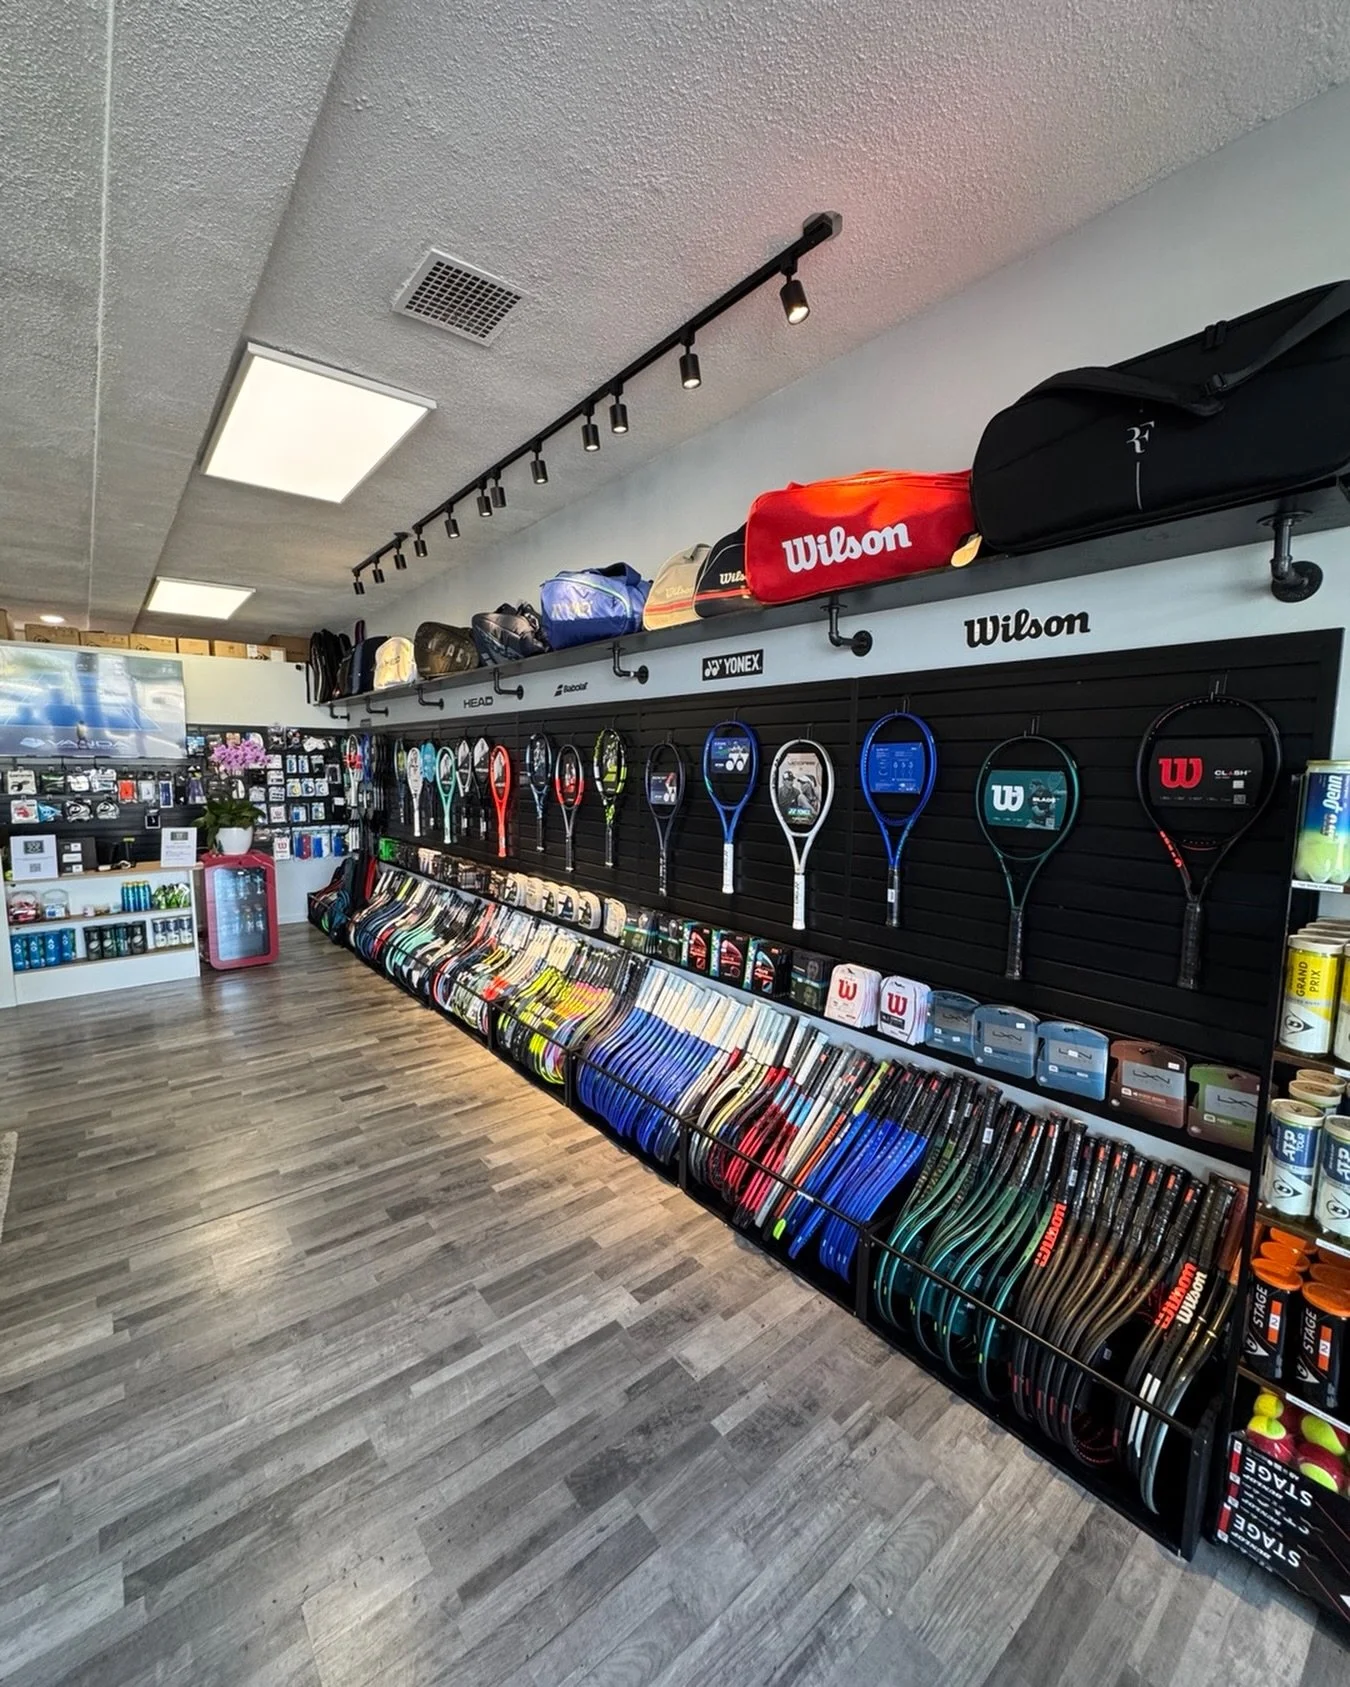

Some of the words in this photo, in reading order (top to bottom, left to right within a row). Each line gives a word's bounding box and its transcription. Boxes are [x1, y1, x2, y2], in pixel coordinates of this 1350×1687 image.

[782, 522, 912, 574] Wilson
[719, 569, 747, 585] Wils
[964, 608, 1091, 649] Wilson
[724, 653, 761, 675] YONEX
[463, 696, 494, 709] HEAD
[563, 682, 589, 694] Babolat
[1158, 757, 1203, 789] W
[1296, 960, 1309, 998] GRAND
[1309, 969, 1322, 993] PRIX
[1282, 1129, 1298, 1162] ATP
[1296, 1133, 1305, 1153] TOUR
[1175, 1270, 1208, 1325] Wilson
[1253, 1283, 1269, 1329] STAGE
[1270, 1317, 1279, 1328] 2
[1302, 1307, 1318, 1355] STAGE
[1321, 1342, 1330, 1354] 2
[1243, 1455, 1314, 1508] STAGE
[1232, 1512, 1302, 1568] STAGE
